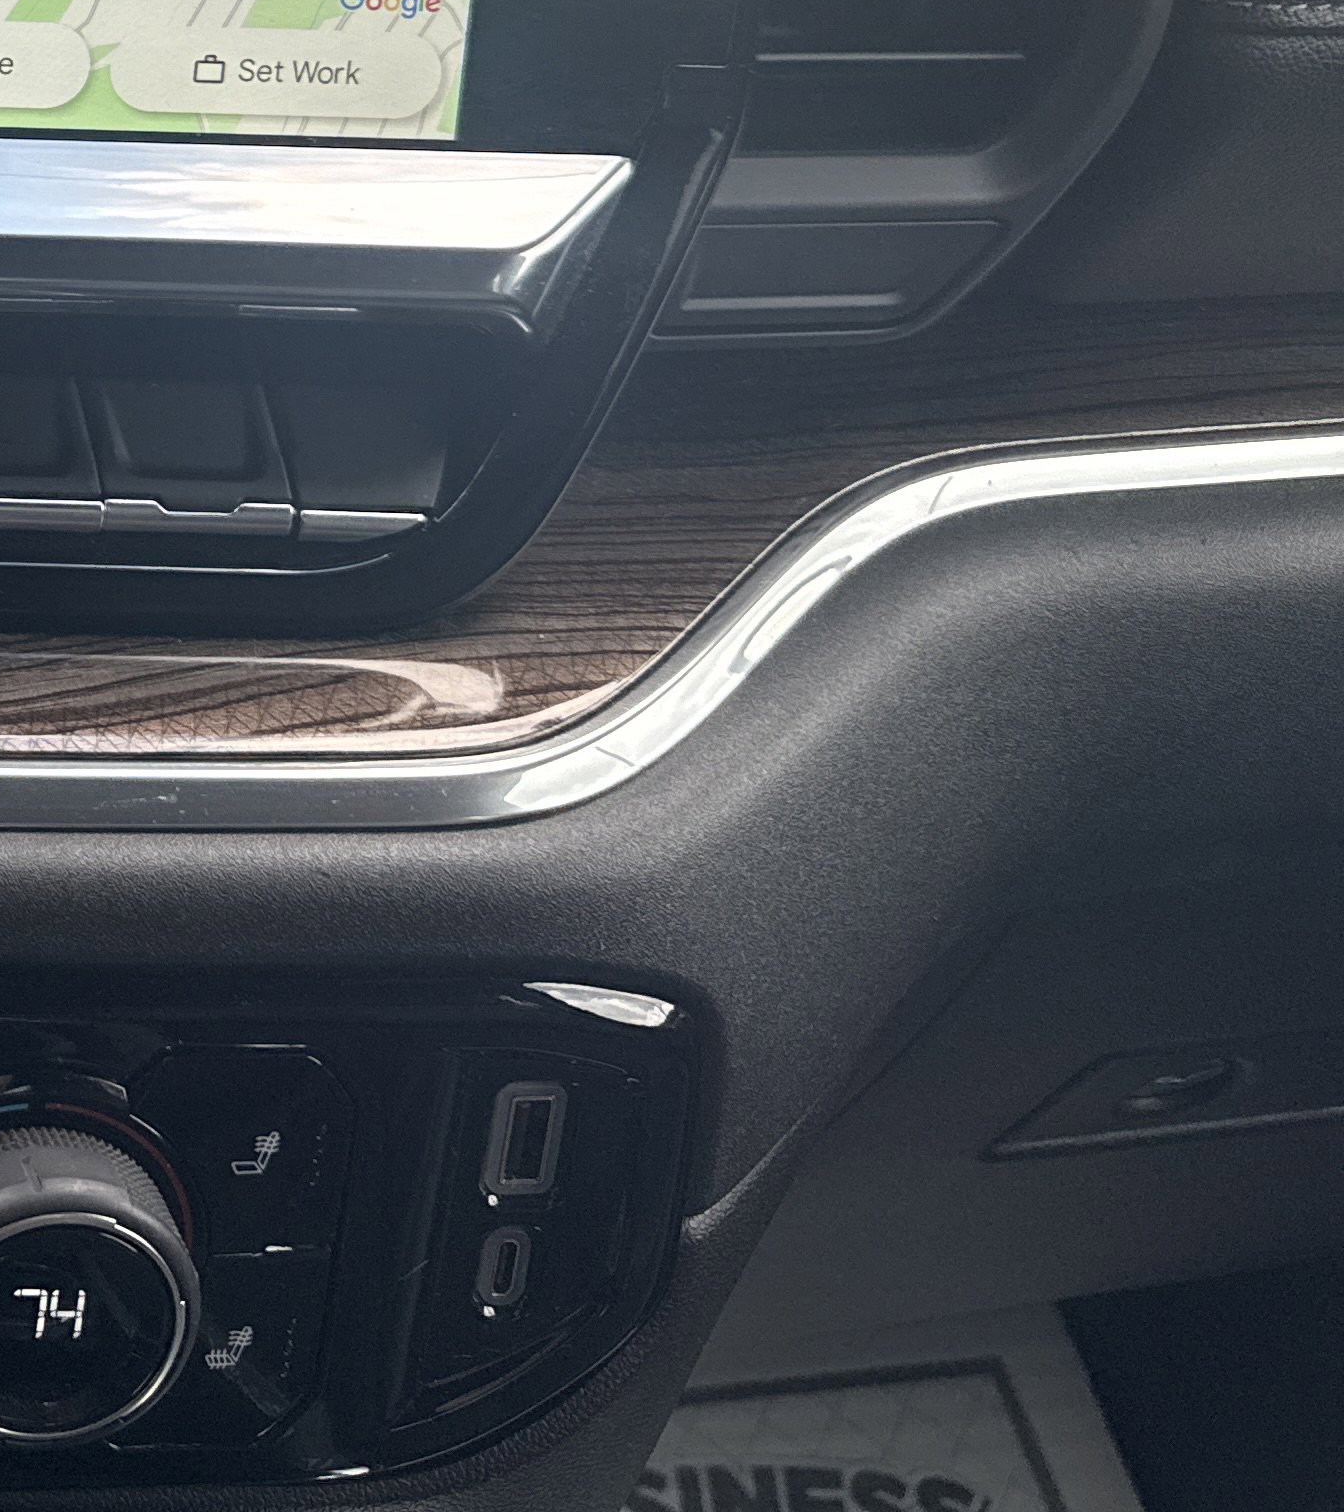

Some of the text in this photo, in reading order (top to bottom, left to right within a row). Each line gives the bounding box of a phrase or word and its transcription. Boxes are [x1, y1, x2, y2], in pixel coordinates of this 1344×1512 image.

[238, 58, 361, 85] Set Work
[13, 1288, 86, 1339] 74
